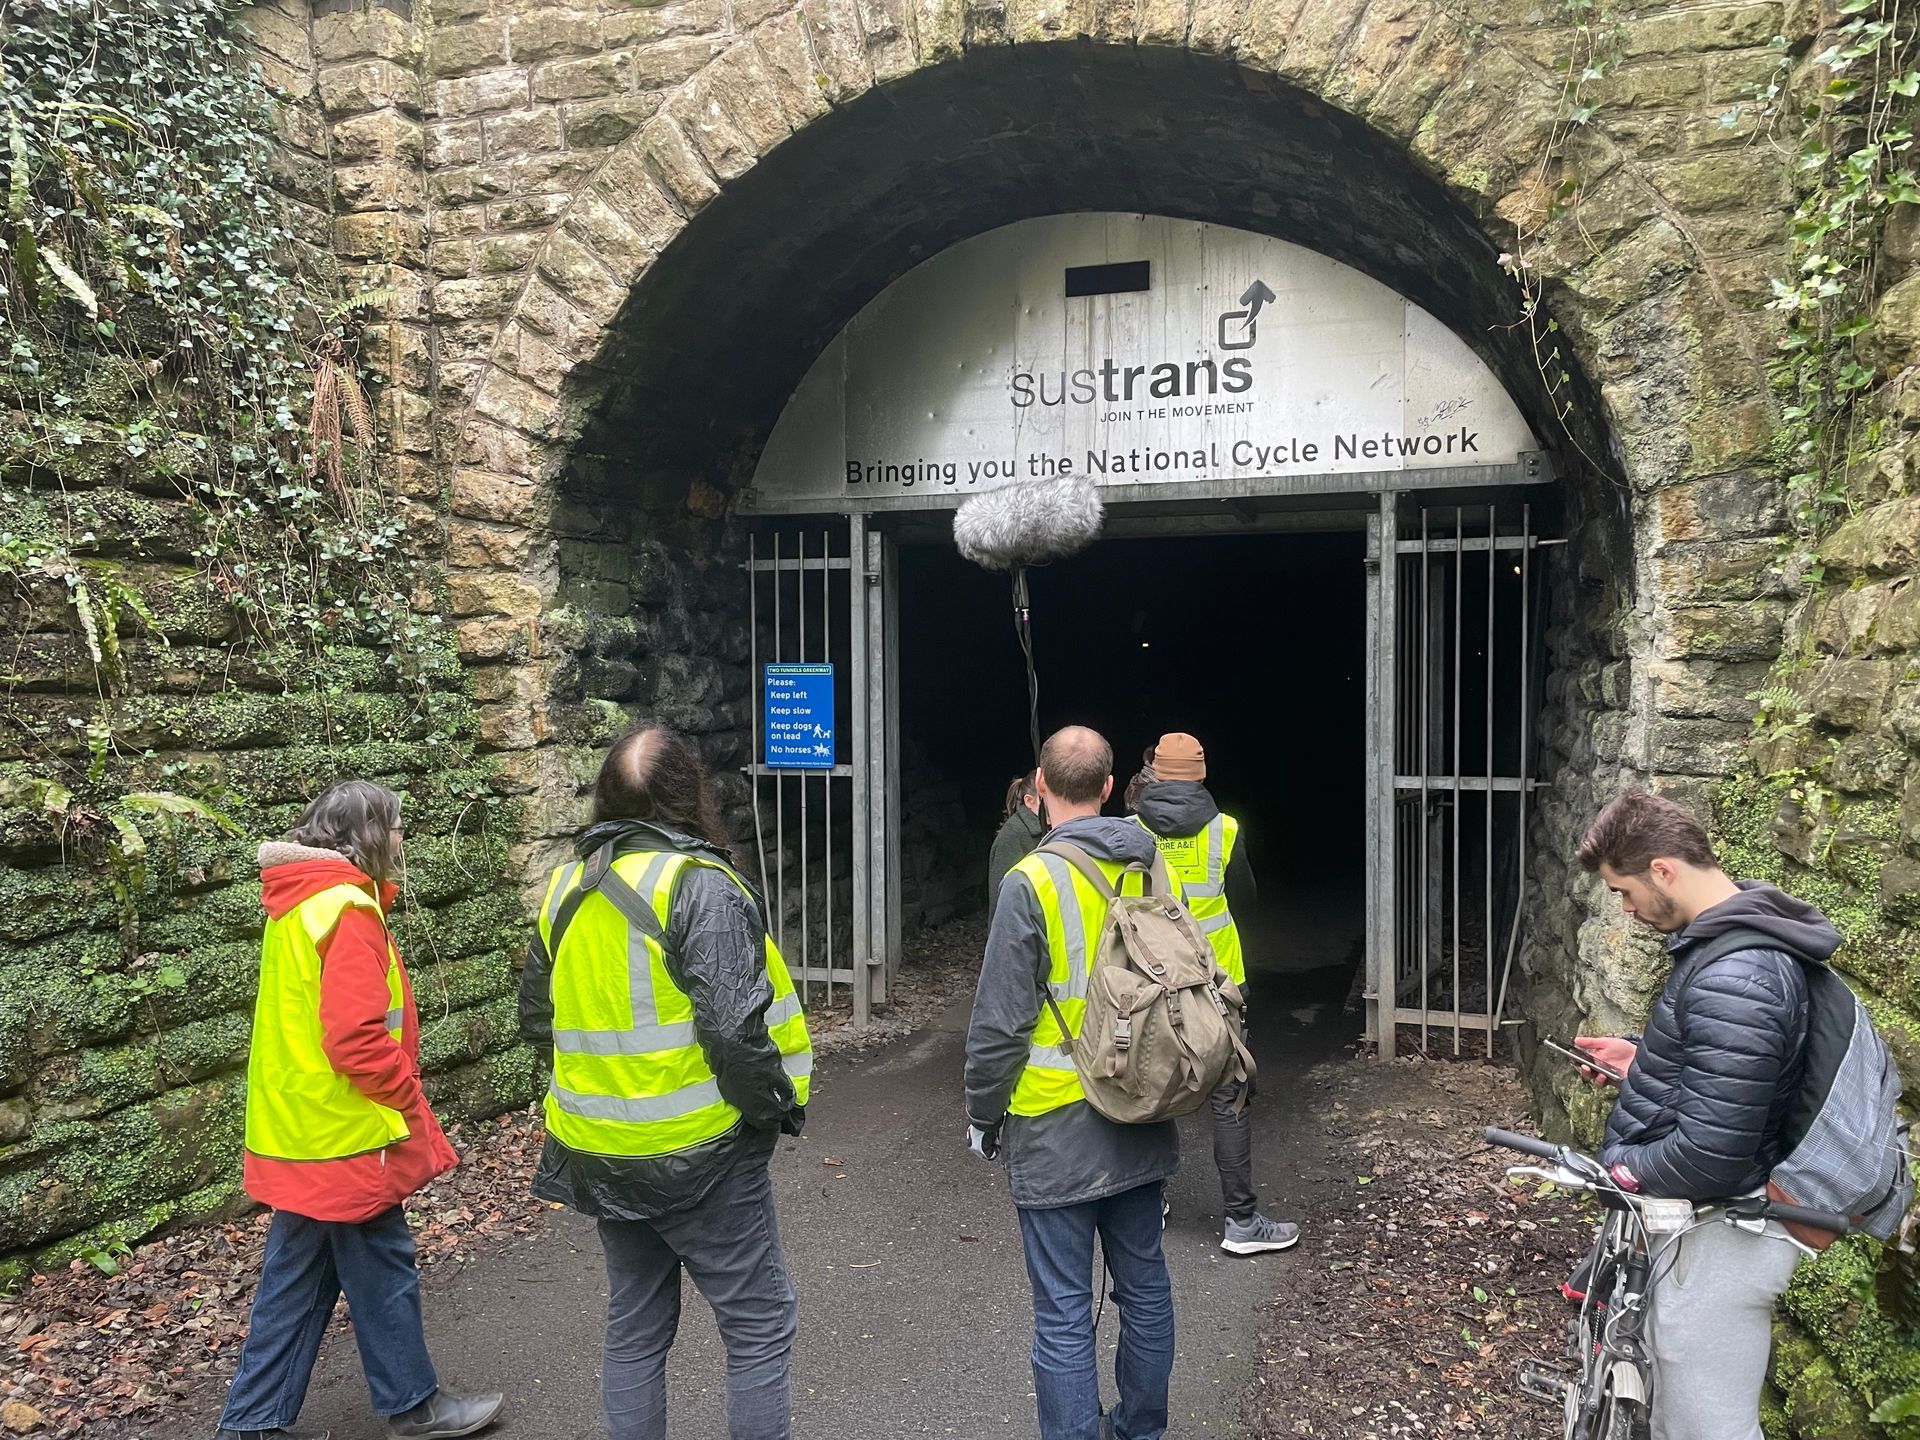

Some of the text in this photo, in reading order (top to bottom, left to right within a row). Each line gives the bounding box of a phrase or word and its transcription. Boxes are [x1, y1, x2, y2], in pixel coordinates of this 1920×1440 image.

[1011, 358, 1253, 408] sustrans
[1100, 402, 1255, 423] JOIN THE MOVEMENT
[846, 427, 1479, 487] Bringing you the National Cycle Network
[767, 678, 796, 686] Please:
[770, 691, 807, 700] Keep left
[770, 706, 811, 715] Keep slow
[770, 722, 812, 731] Keep dogs
[783, 732, 801, 740] lead
[770, 745, 811, 754] No horses
[1177, 841, 1195, 849] A&E
